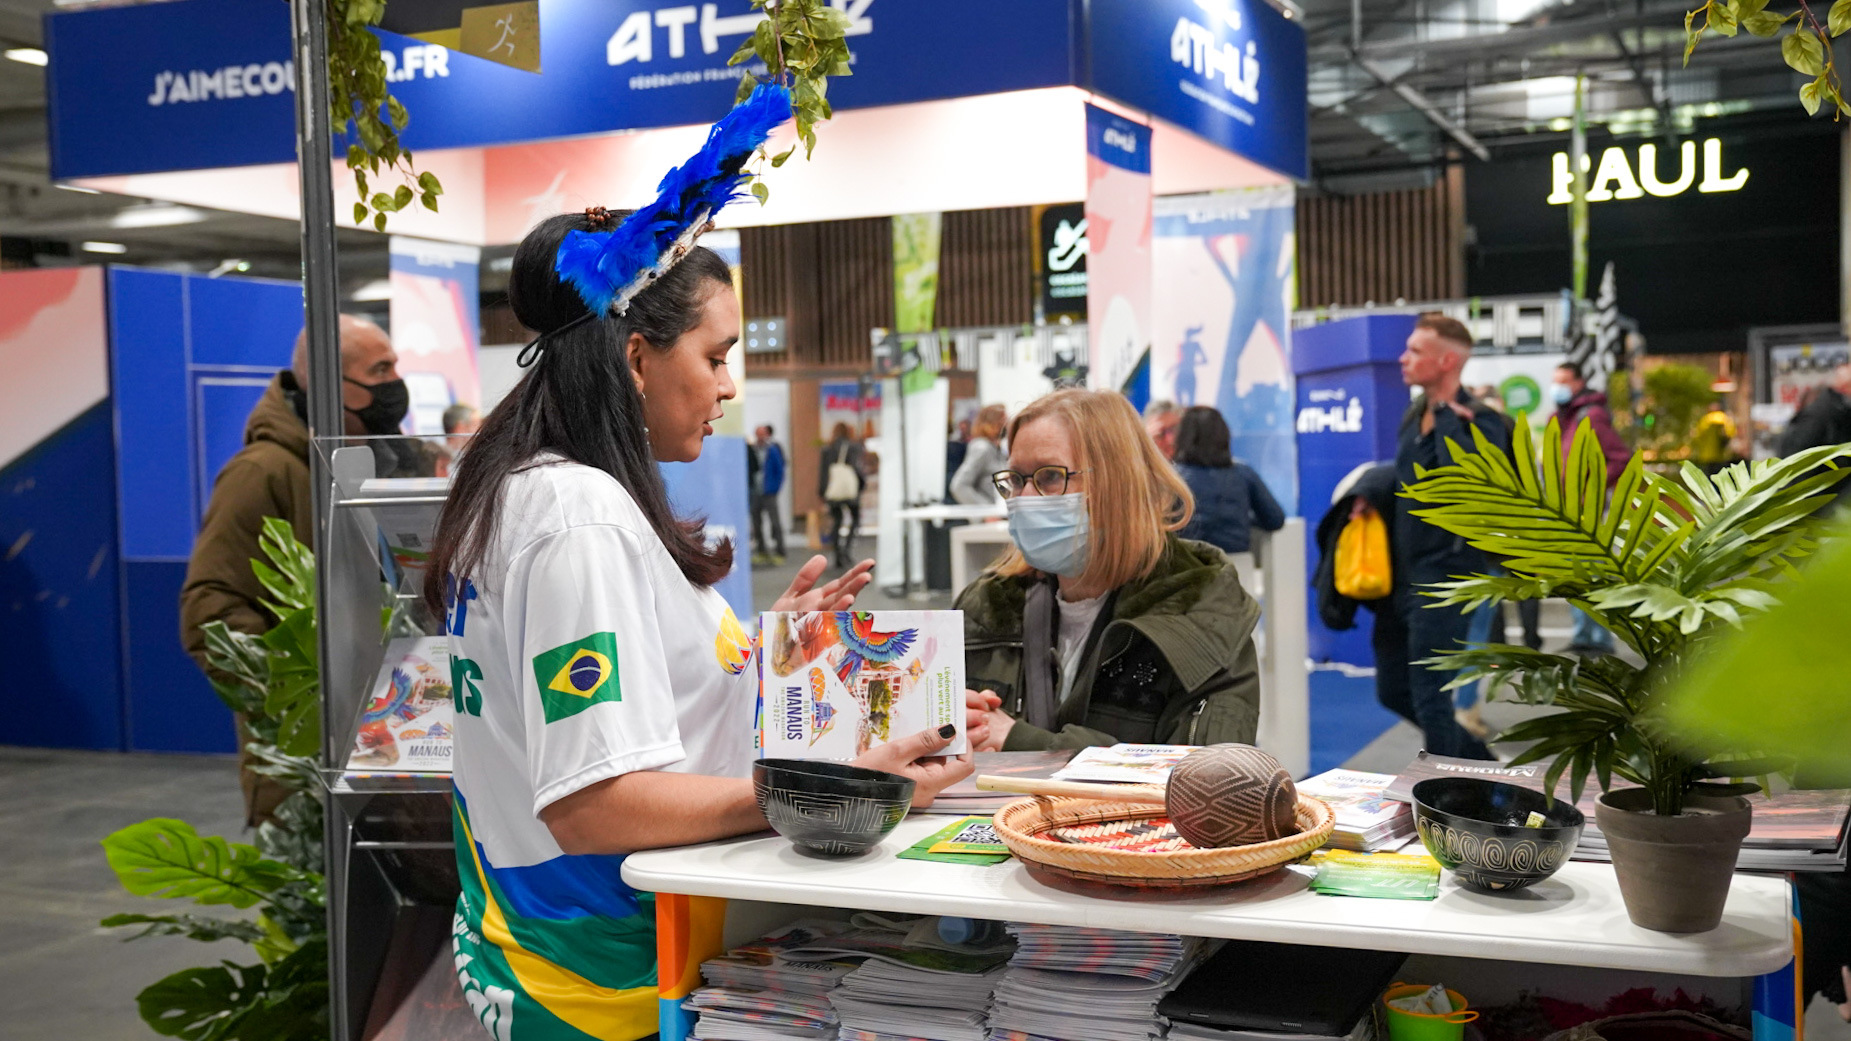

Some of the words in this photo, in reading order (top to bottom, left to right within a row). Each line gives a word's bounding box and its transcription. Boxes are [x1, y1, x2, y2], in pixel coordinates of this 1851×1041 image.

[1547, 138, 1749, 204] PAUL
[787, 686, 803, 740] MANAUS
[804, 716, 810, 725] TO
[408, 745, 452, 757] MANAUS
